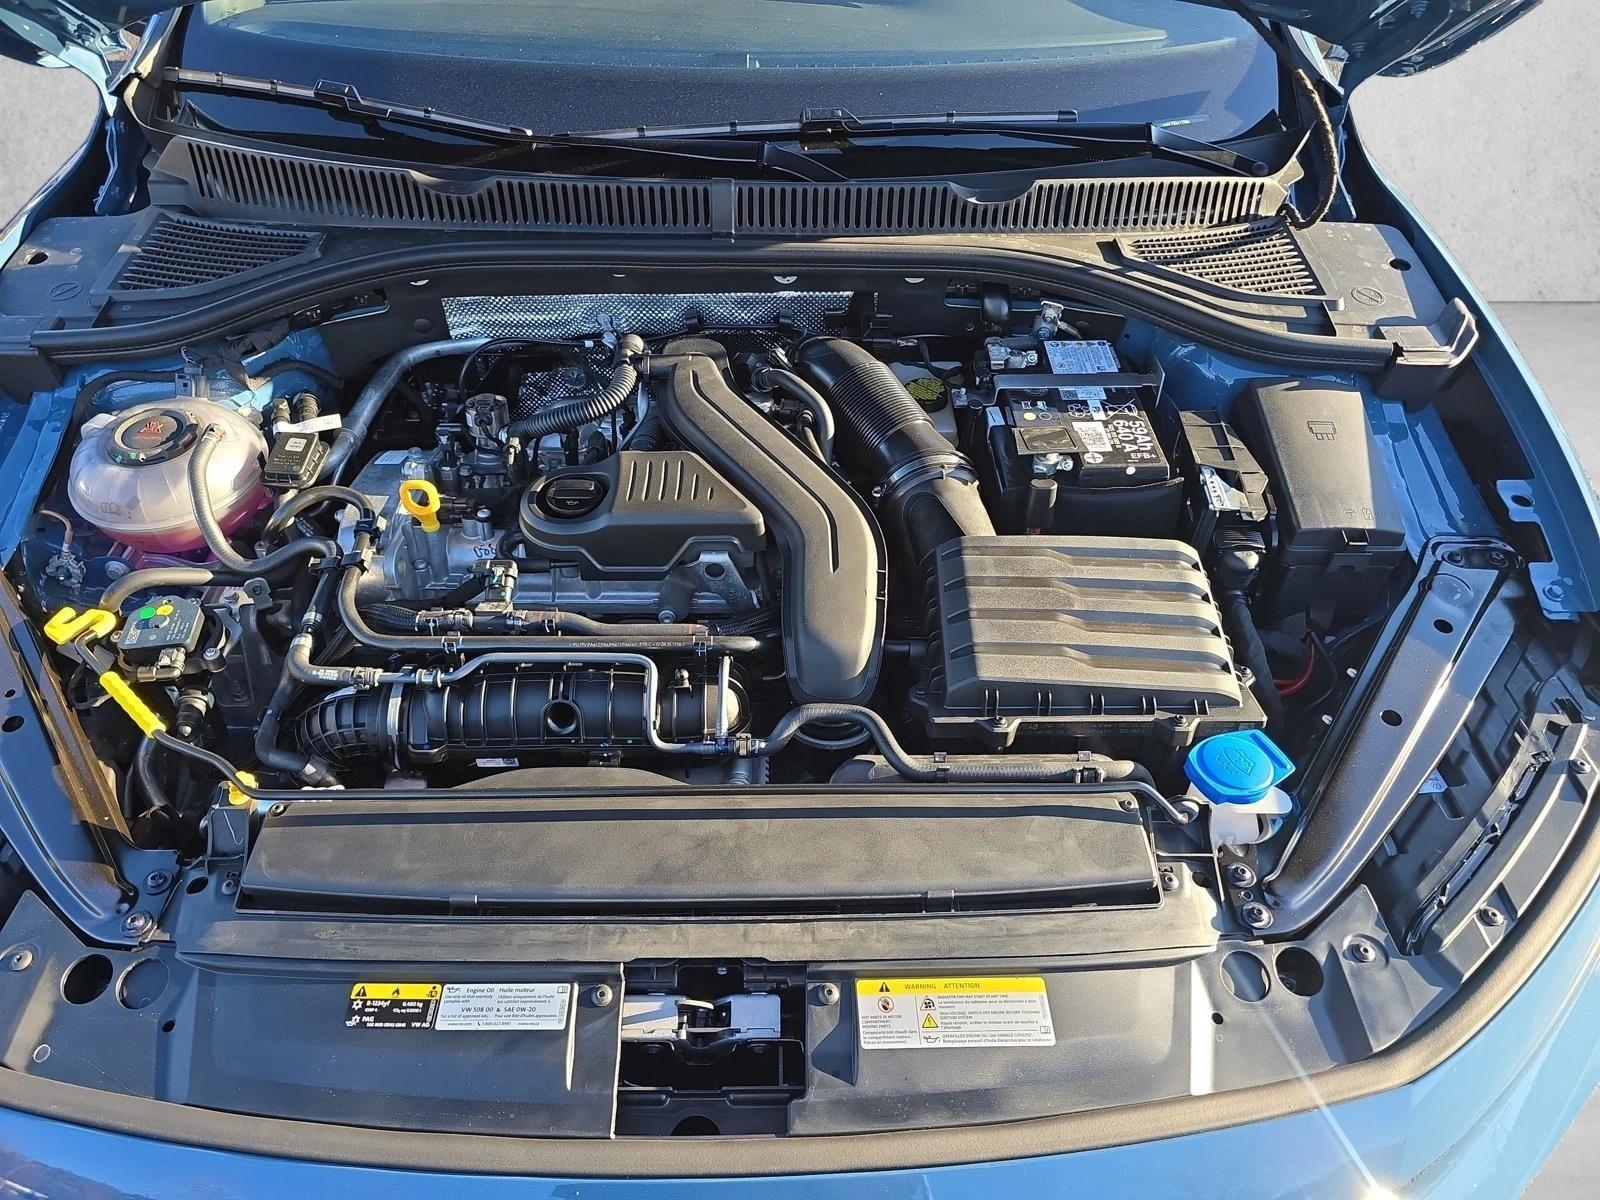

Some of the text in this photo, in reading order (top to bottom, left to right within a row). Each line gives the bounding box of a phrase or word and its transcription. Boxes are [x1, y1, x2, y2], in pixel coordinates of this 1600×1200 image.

[1112, 420, 1135, 440] 640
[1128, 420, 1154, 451] 59Ah
[1121, 443, 1138, 452] A
